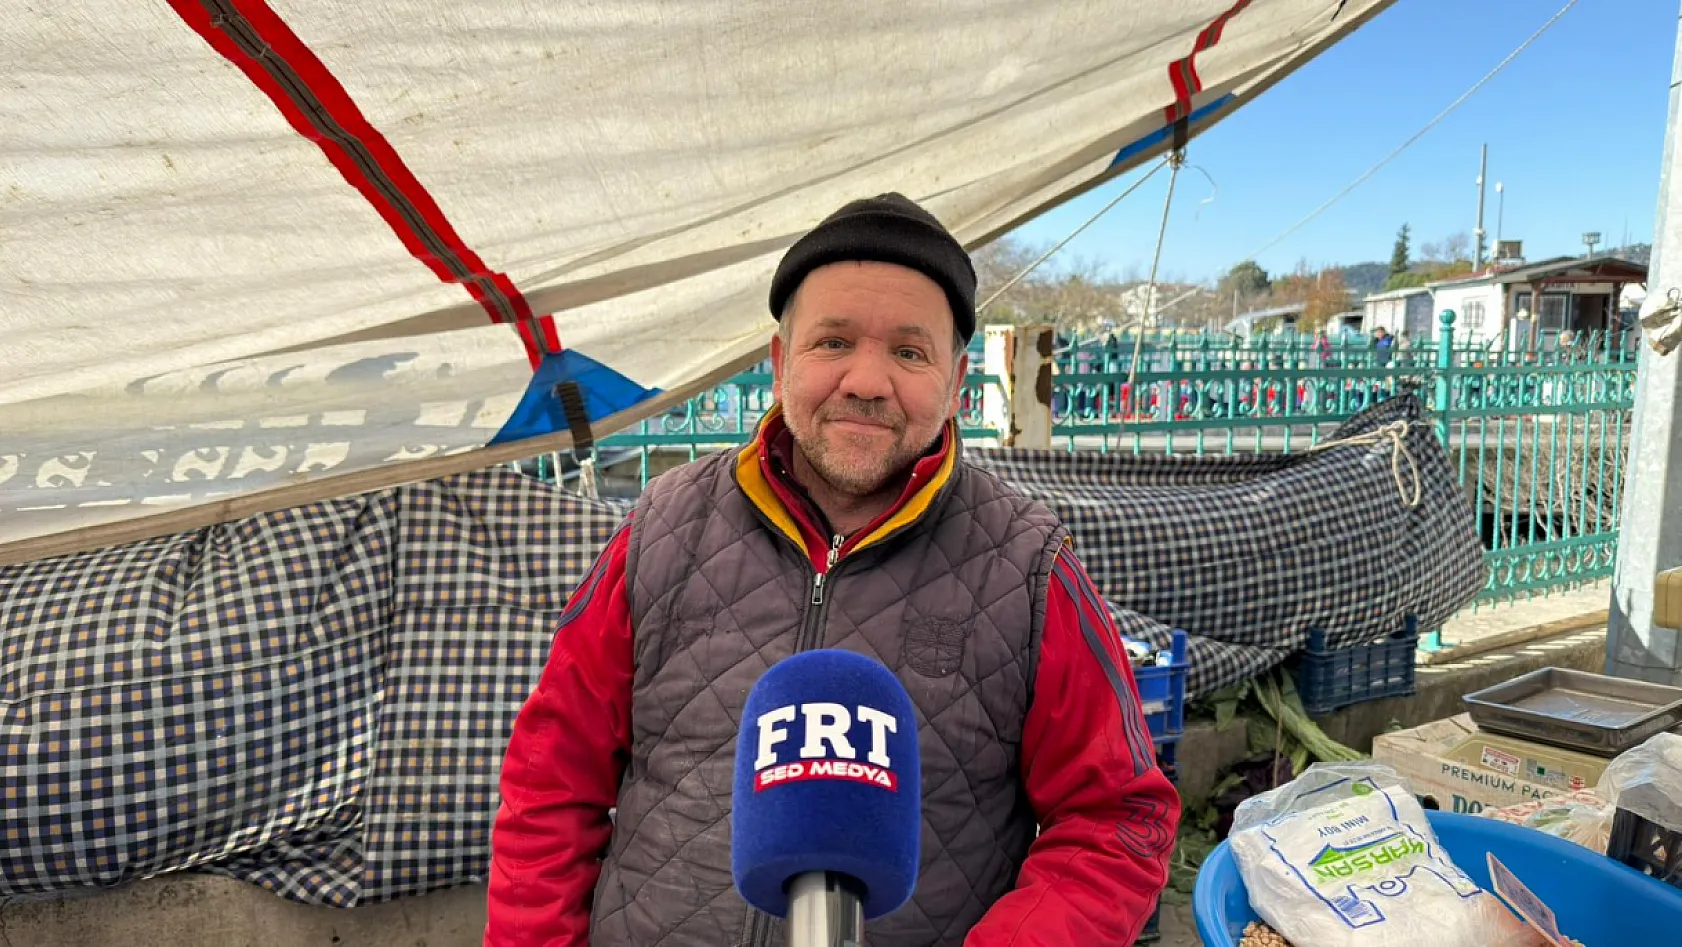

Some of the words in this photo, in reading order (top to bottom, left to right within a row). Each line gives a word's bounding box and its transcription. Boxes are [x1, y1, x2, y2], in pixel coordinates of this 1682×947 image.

[754, 702, 897, 770] FRT
[760, 764, 804, 785] SED
[809, 761, 892, 788] MEDYA
[1441, 763, 1515, 793] PREMIUM
[1313, 837, 1425, 880] KARSAN
